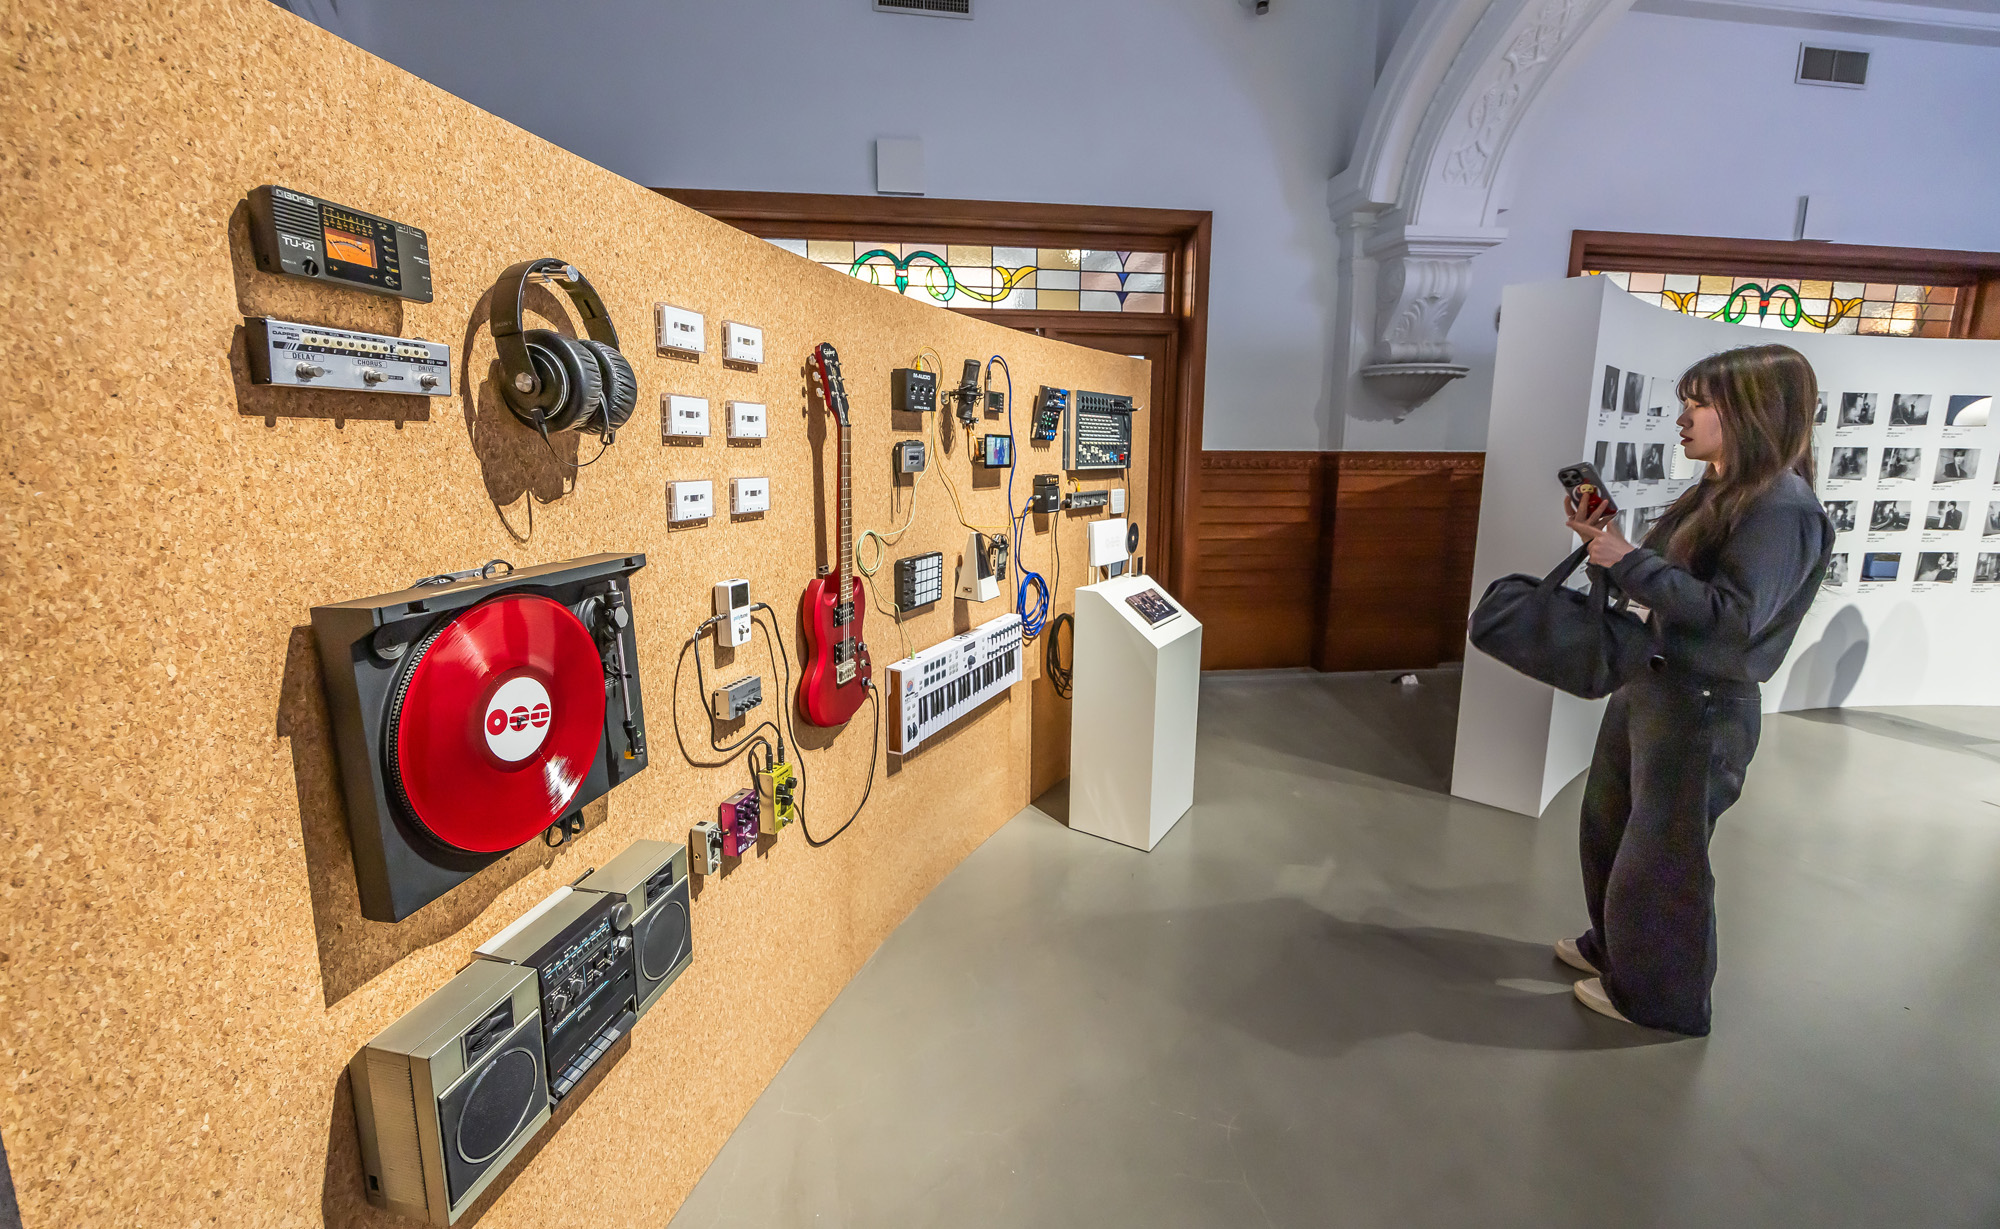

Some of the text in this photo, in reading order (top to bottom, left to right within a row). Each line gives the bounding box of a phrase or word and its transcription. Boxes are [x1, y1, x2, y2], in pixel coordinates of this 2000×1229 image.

[281, 235, 316, 252] TU-121
[272, 330, 300, 338] DAPPER
[292, 352, 316, 361] DELAY
[357, 359, 383, 367] CHORUS
[418, 365, 435, 373] DRIVE
[912, 372, 931, 381] M-AUDIO
